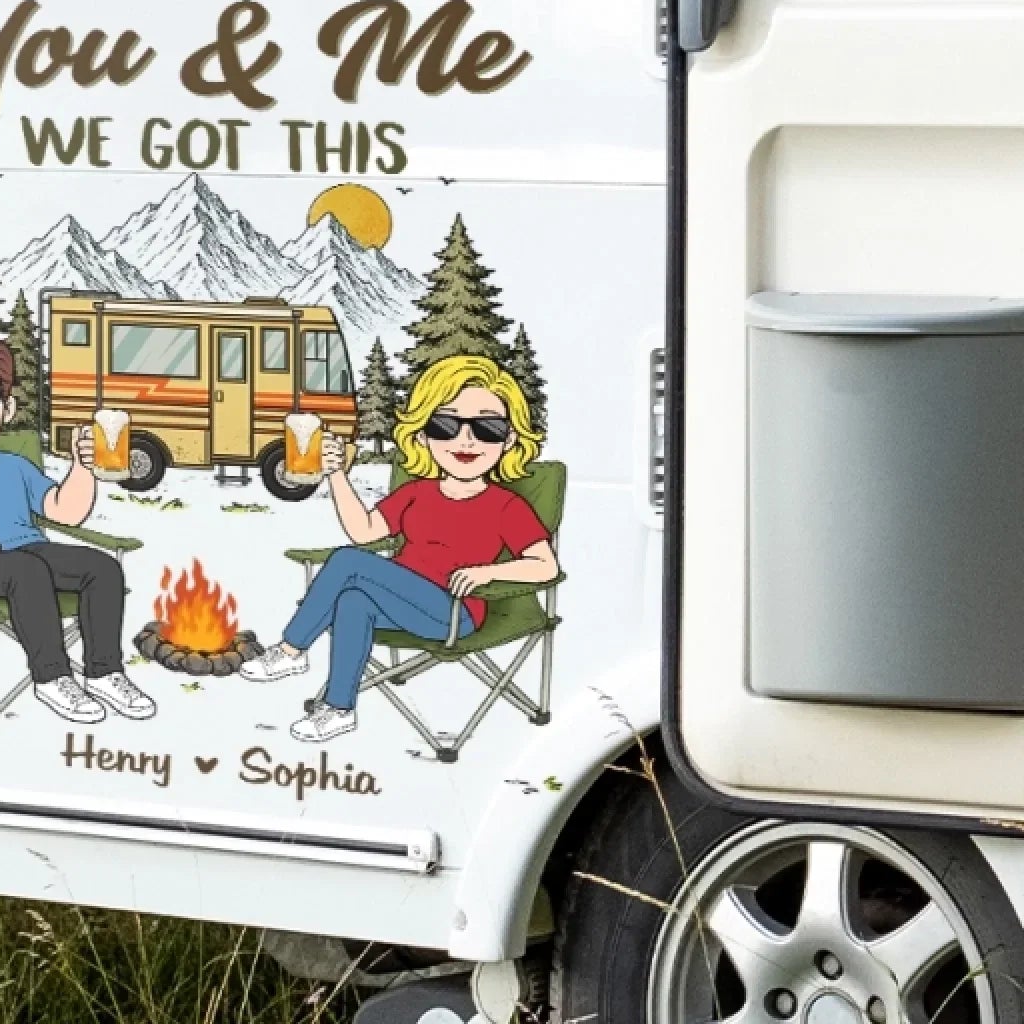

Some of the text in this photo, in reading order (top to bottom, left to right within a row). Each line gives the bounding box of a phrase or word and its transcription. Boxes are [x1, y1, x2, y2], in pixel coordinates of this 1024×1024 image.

[179, 0, 282, 110] &
[20, 115, 408, 174] WE GOT THIS
[60, 732, 382, 800] Henry Sophia
